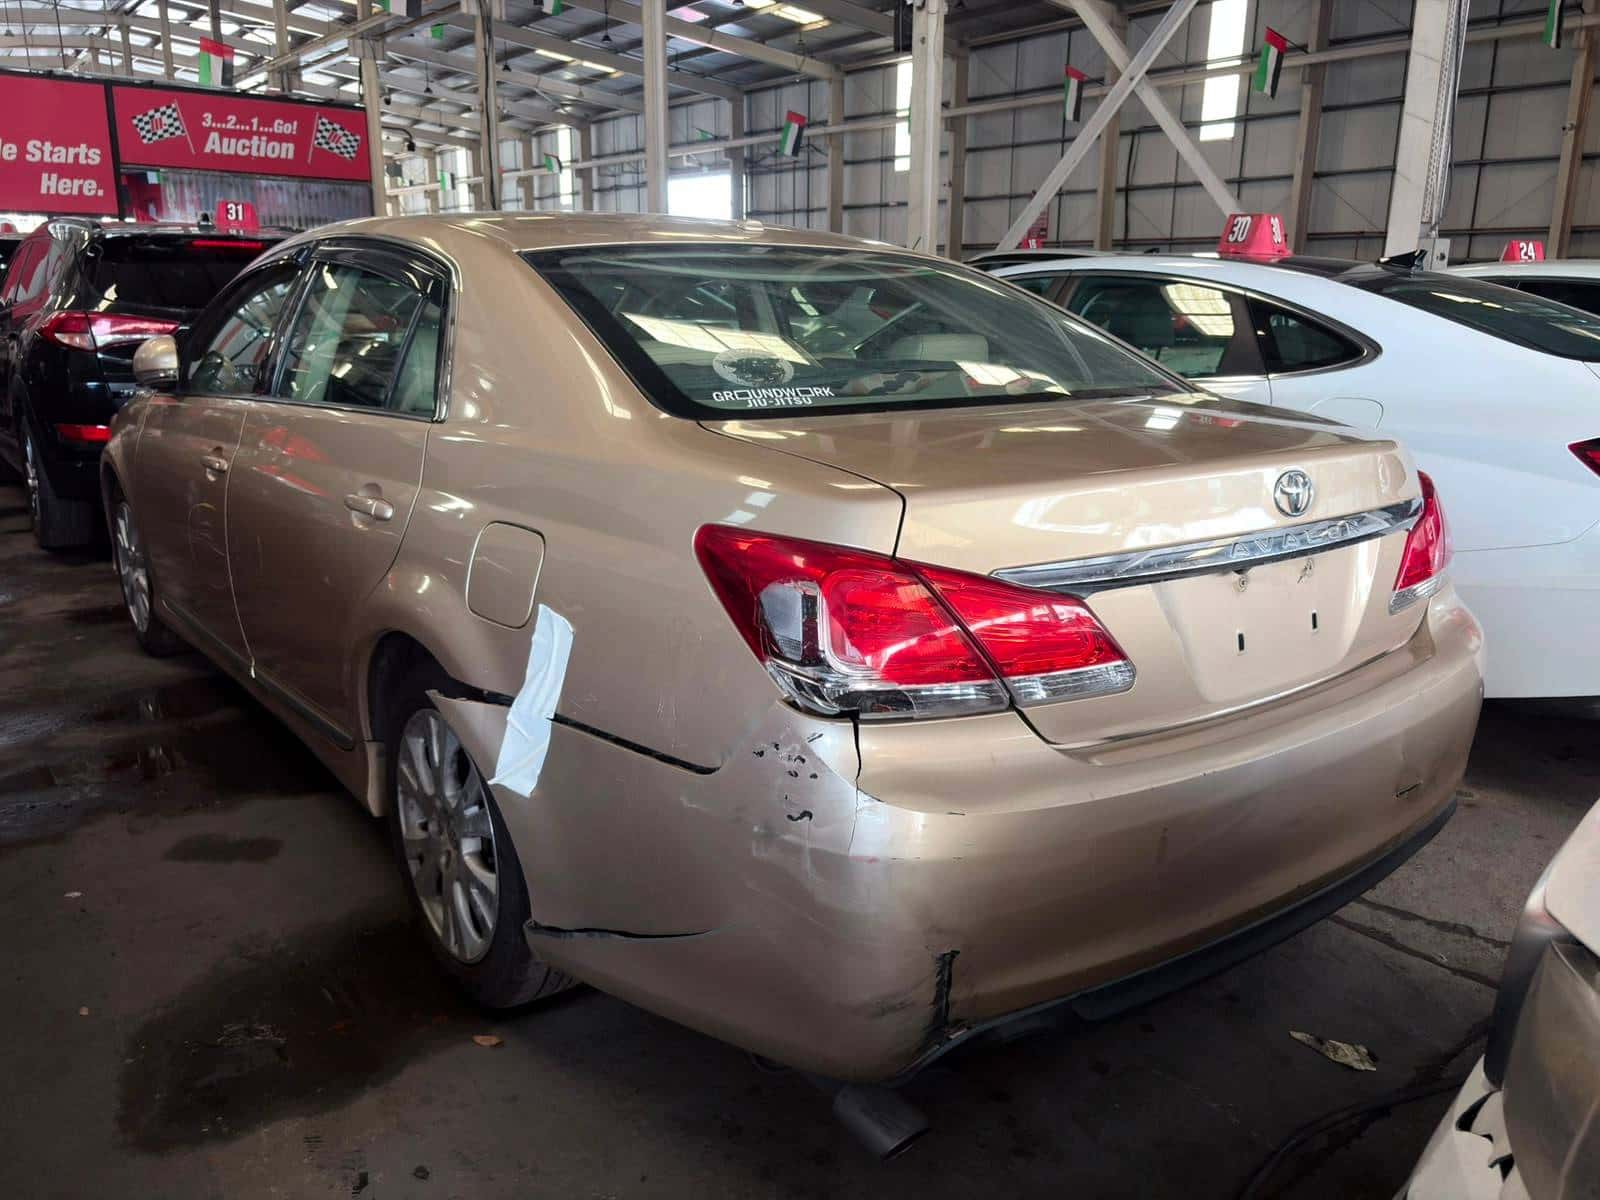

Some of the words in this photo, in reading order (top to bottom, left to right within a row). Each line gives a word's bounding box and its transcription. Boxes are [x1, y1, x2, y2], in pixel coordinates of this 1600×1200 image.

[26, 140, 101, 165] Starts
[204, 131, 295, 160] Auction
[40, 173, 104, 197] Here.
[227, 203, 243, 221] 31
[1228, 216, 1252, 242] 30
[1519, 242, 1535, 261] 24
[712, 386, 835, 402] GROUNDWORK
[747, 397, 813, 408] JIU-JITSU
